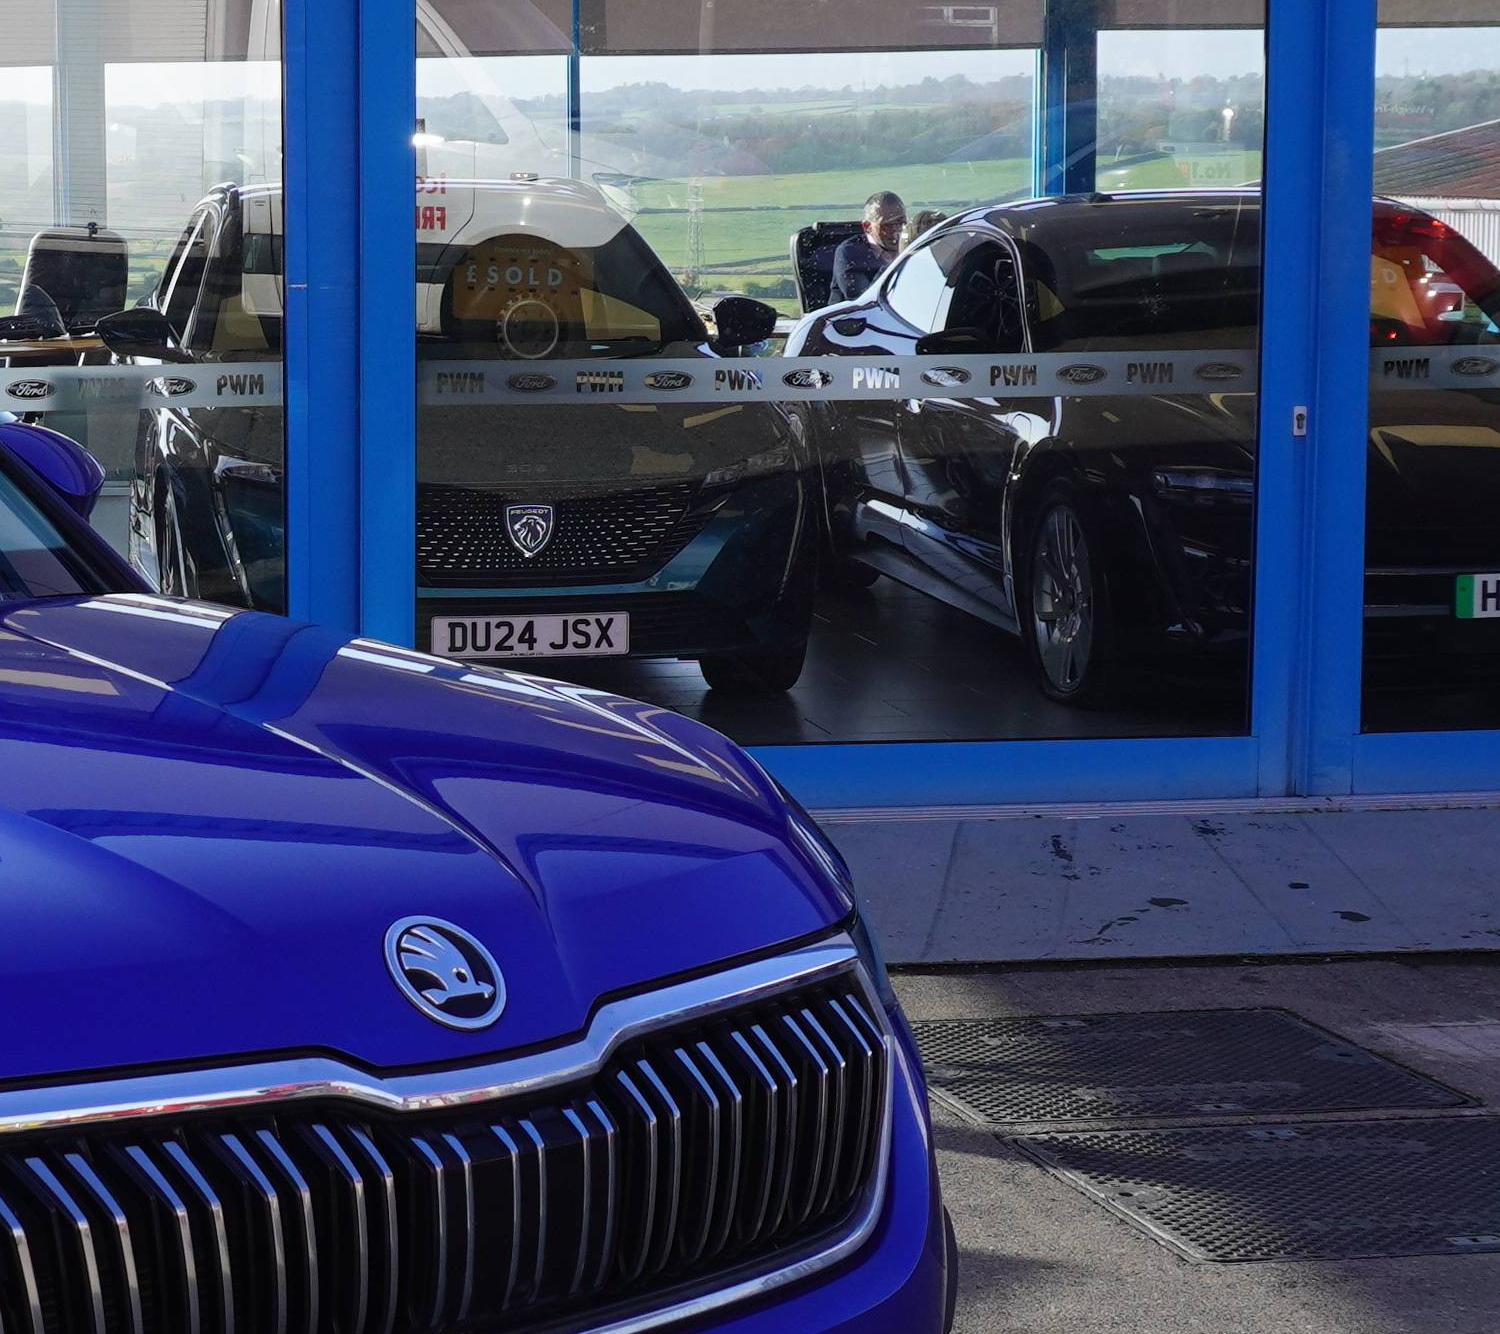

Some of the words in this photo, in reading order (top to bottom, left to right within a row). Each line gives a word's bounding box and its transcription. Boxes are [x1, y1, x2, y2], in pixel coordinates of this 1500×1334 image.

[488, 265, 563, 286] SOLD
[436, 372, 485, 394] PWM
[510, 374, 555, 391] Ford
[576, 370, 624, 393] PWM
[647, 373, 692, 389] Ford
[852, 367, 900, 389] PWM
[989, 364, 1037, 386] PWM
[1058, 367, 1105, 382] Ford
[1126, 363, 1174, 383] PWM
[1382, 358, 1430, 379] PWM
[9, 380, 54, 399] Ford
[216, 375, 264, 396] PWM
[448, 622, 537, 652] DU24
[549, 617, 615, 649] JSX
